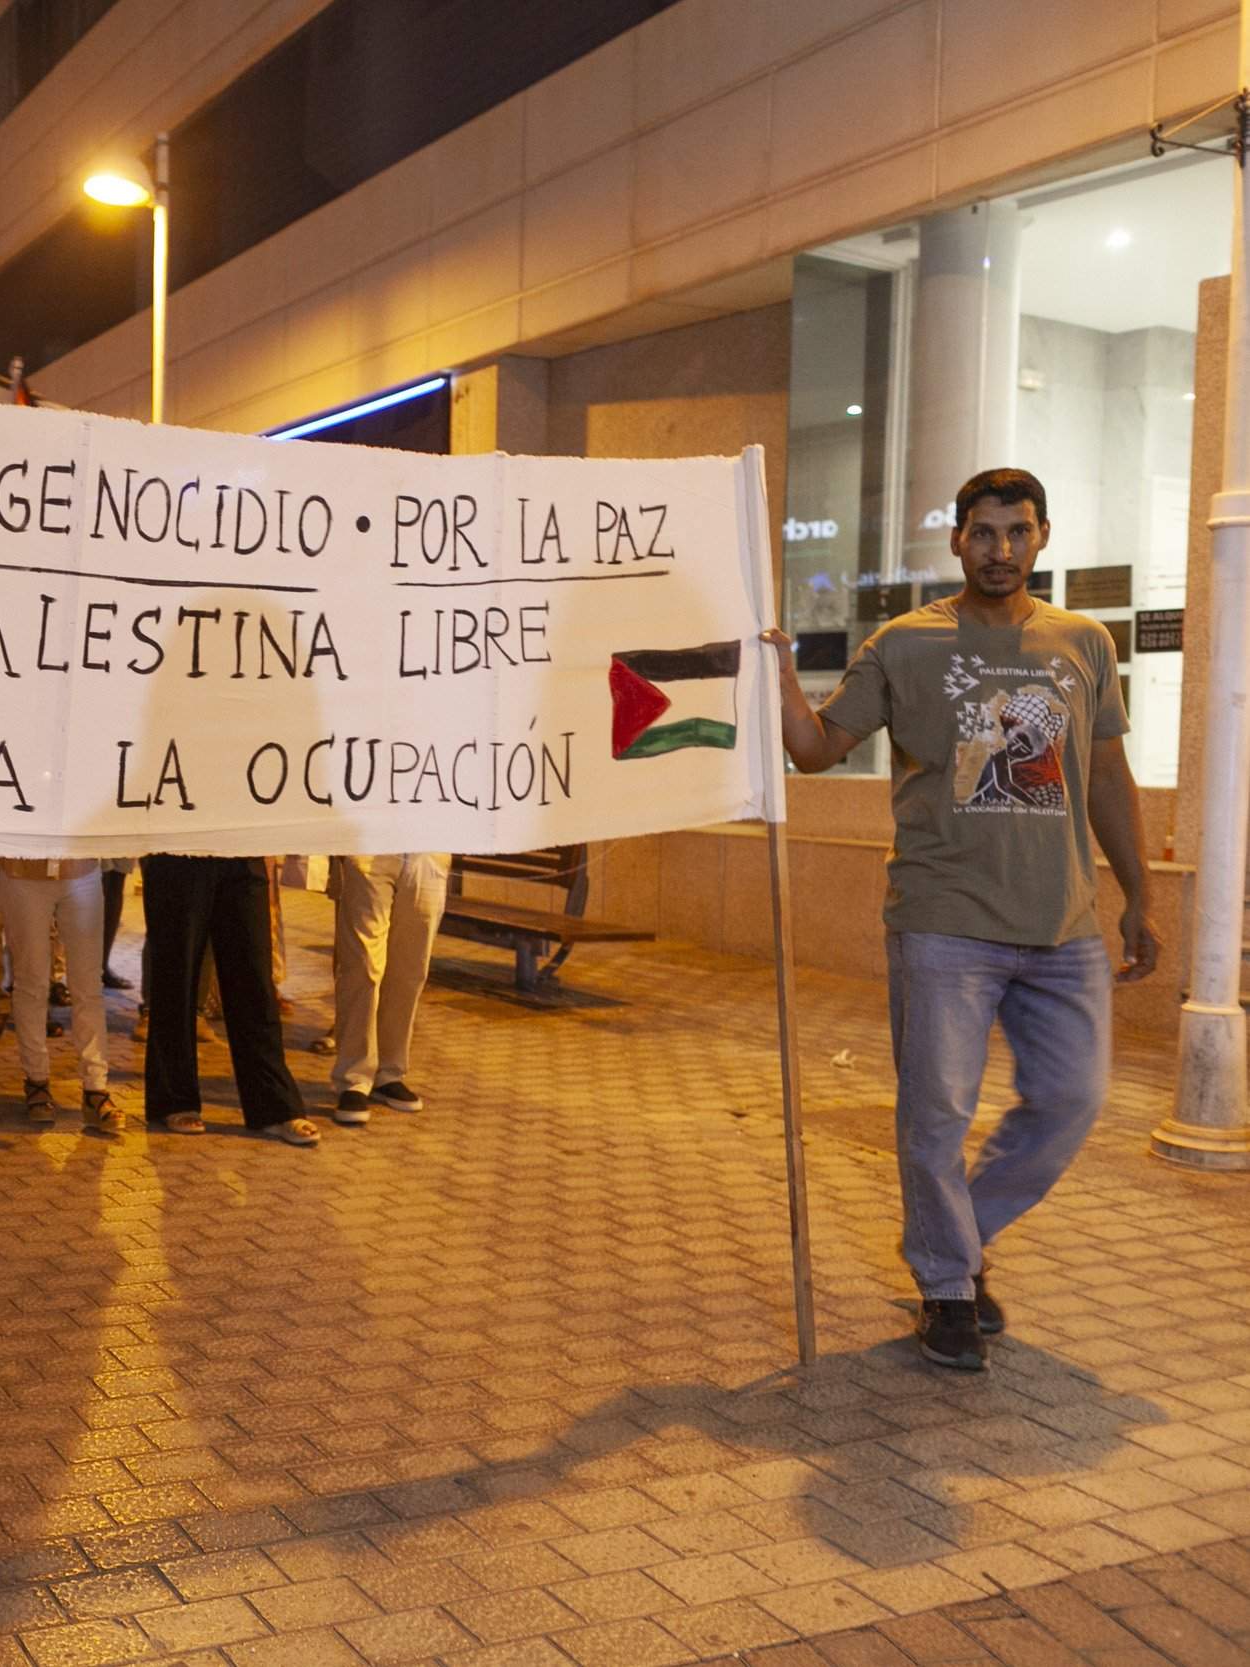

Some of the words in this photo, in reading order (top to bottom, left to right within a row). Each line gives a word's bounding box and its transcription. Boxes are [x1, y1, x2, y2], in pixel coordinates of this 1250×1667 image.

[390, 494, 488, 571] POR
[517, 497, 570, 564] LA
[592, 500, 675, 565] PAZ
[399, 600, 552, 680] LIBRE
[978, 667, 1029, 678] PALESTINA
[1030, 669, 1057, 679] LIBRE
[115, 738, 196, 811] LA
[245, 715, 576, 812] OCUPACIÓN
